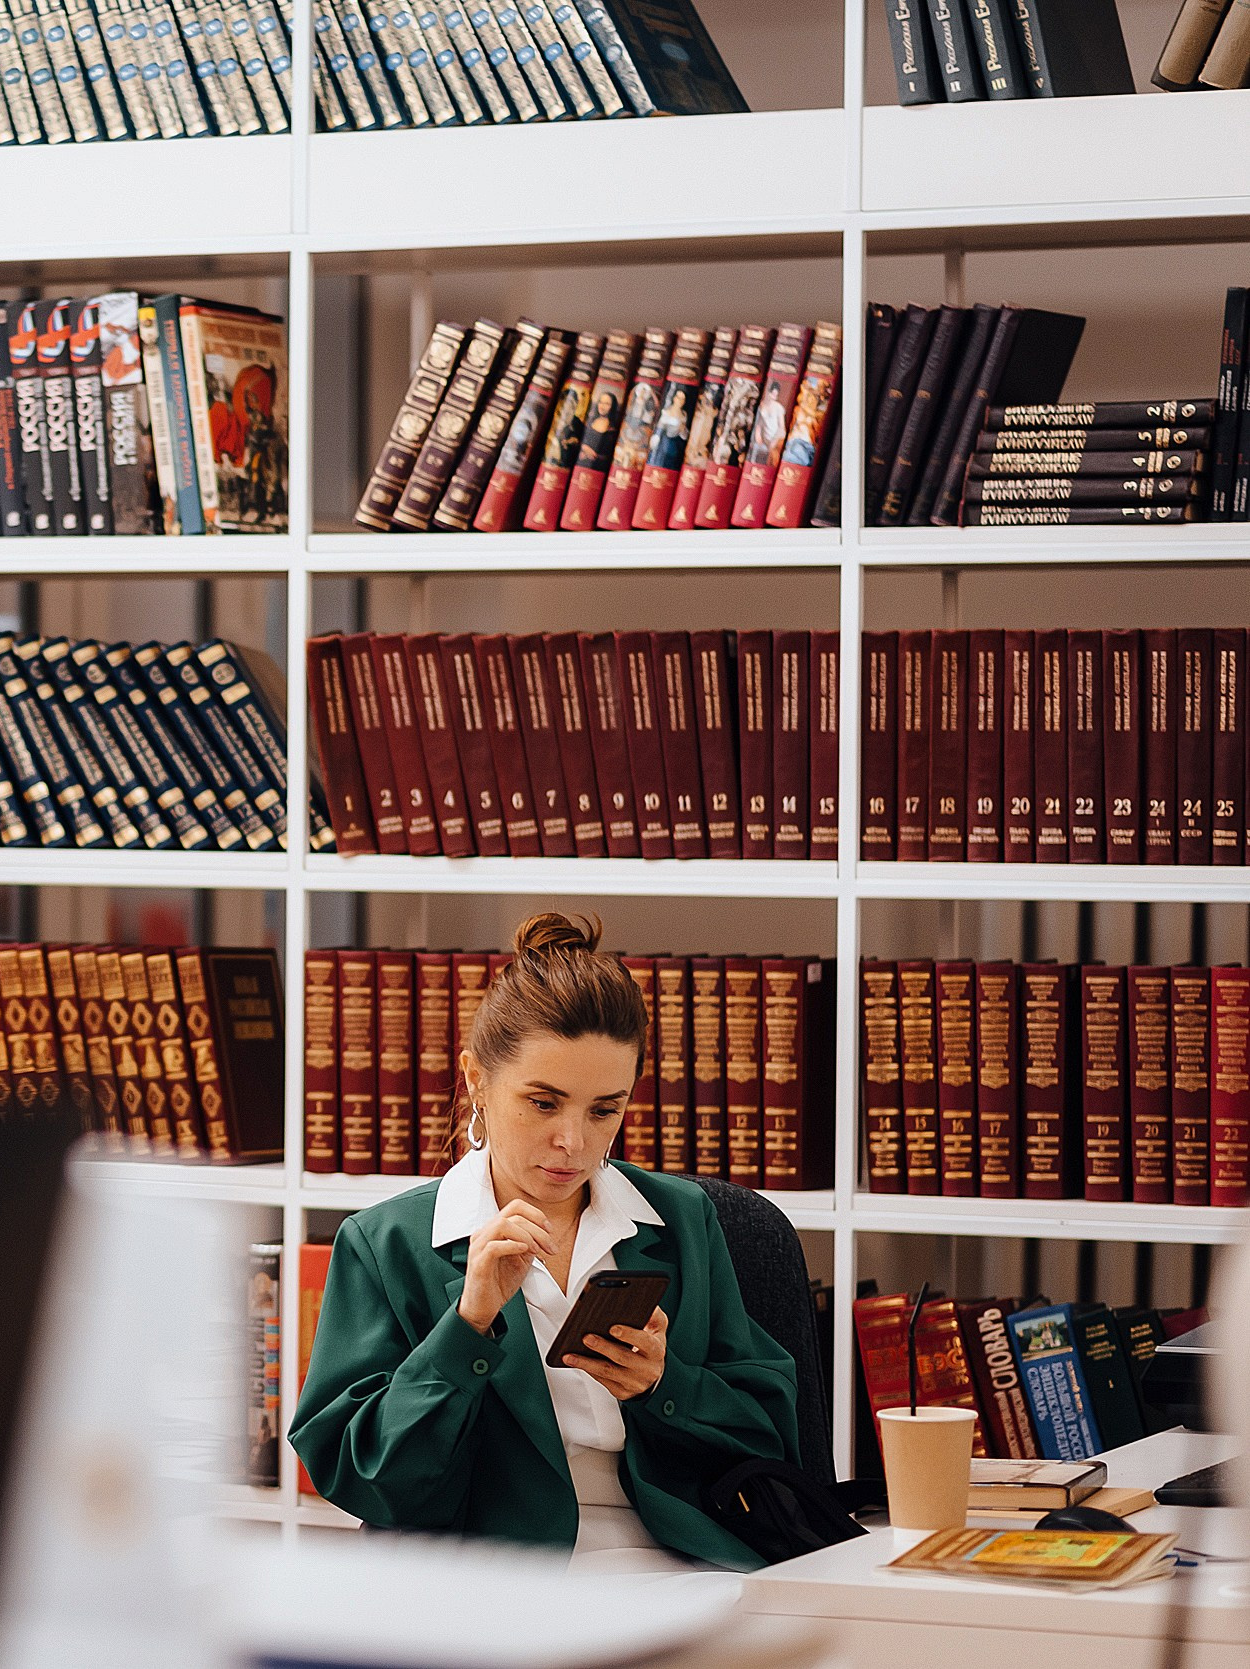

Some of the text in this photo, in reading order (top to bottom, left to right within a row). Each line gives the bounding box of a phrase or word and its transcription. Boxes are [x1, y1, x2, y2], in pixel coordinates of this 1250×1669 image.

[16, 380, 41, 452] РОССИЯ
[45, 380, 68, 452] РОССИЯ
[75, 379, 97, 451] РОССИЯ
[1147, 406, 1161, 416] 2
[111, 391, 129, 465] РОССИЯ
[1138, 431, 1152, 442] 5
[1132, 457, 1146, 467] 4
[1123, 481, 1137, 491] 3
[345, 795, 353, 812] 1
[380, 788, 392, 807] 2
[410, 788, 422, 807] 3
[443, 789, 455, 808] 4
[480, 790, 492, 809] 5
[511, 792, 524, 810] 6
[546, 789, 556, 808] 7
[578, 793, 590, 811] 8
[612, 792, 624, 810] 9
[643, 792, 660, 811] 10
[677, 794, 692, 812] 11
[712, 792, 728, 811] 12
[750, 794, 765, 813] 13
[782, 795, 797, 813] 14
[819, 797, 835, 815] 15
[869, 797, 885, 815] 16
[905, 796, 920, 815] 17
[939, 796, 956, 815] 18
[977, 796, 993, 815] 19
[1010, 796, 1031, 815] 20
[1044, 796, 1061, 815] 21
[1075, 796, 1094, 815] 22
[170, 803, 187, 819] 10
[206, 803, 224, 819] 11
[238, 803, 254, 820] 12
[1113, 798, 1132, 816] 23
[1149, 799, 1166, 817] 24
[1183, 799, 1202, 817] 24
[1216, 799, 1234, 817] 25
[315, 1101, 323, 1114] 1
[353, 1102, 362, 1115] 2
[391, 1104, 399, 1117] 3
[431, 1103, 440, 1115] 4
[667, 1113, 679, 1125] 10
[701, 1115, 711, 1128] 11
[736, 1114, 748, 1128] 12
[774, 1116, 786, 1129] 13
[879, 1117, 891, 1130] 14
[914, 1117, 927, 1130] 15
[952, 1119, 965, 1133] 16
[1037, 1121, 1049, 1135] 18
[989, 1122, 1001, 1135] 17
[1096, 1124, 1110, 1137] 19
[1144, 1124, 1159, 1138] 20
[1184, 1126, 1196, 1140] 21
[1223, 1128, 1239, 1141] 22
[977, 1308, 1018, 1389] СЛОВАРЬ
[917, 1346, 963, 1375] БЭС
[1026, 1366, 1049, 1422] СЛОВАРЬ
[1051, 1361, 1077, 1422] БОЛЬШОЙ
